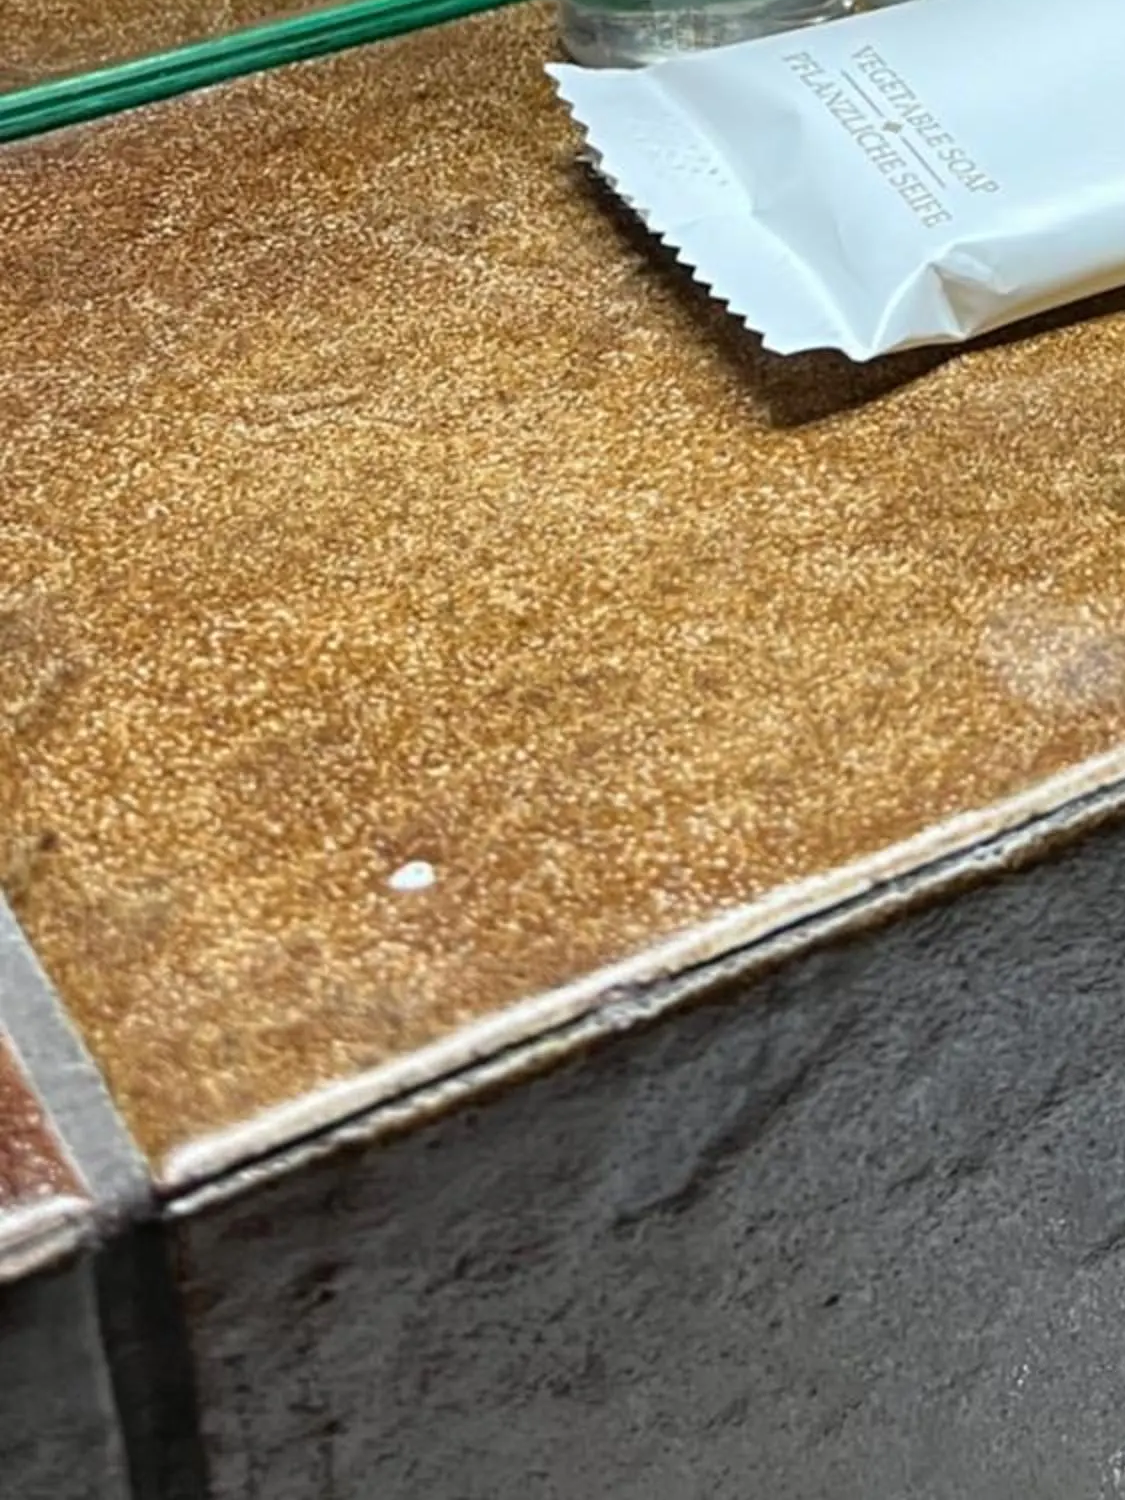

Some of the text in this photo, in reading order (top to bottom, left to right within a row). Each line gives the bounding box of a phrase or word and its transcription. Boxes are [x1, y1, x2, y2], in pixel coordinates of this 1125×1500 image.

[782, 51, 953, 229] PFLANZLICHE SEIFE
[850, 45, 1000, 194] VEGETABLE SOAP
